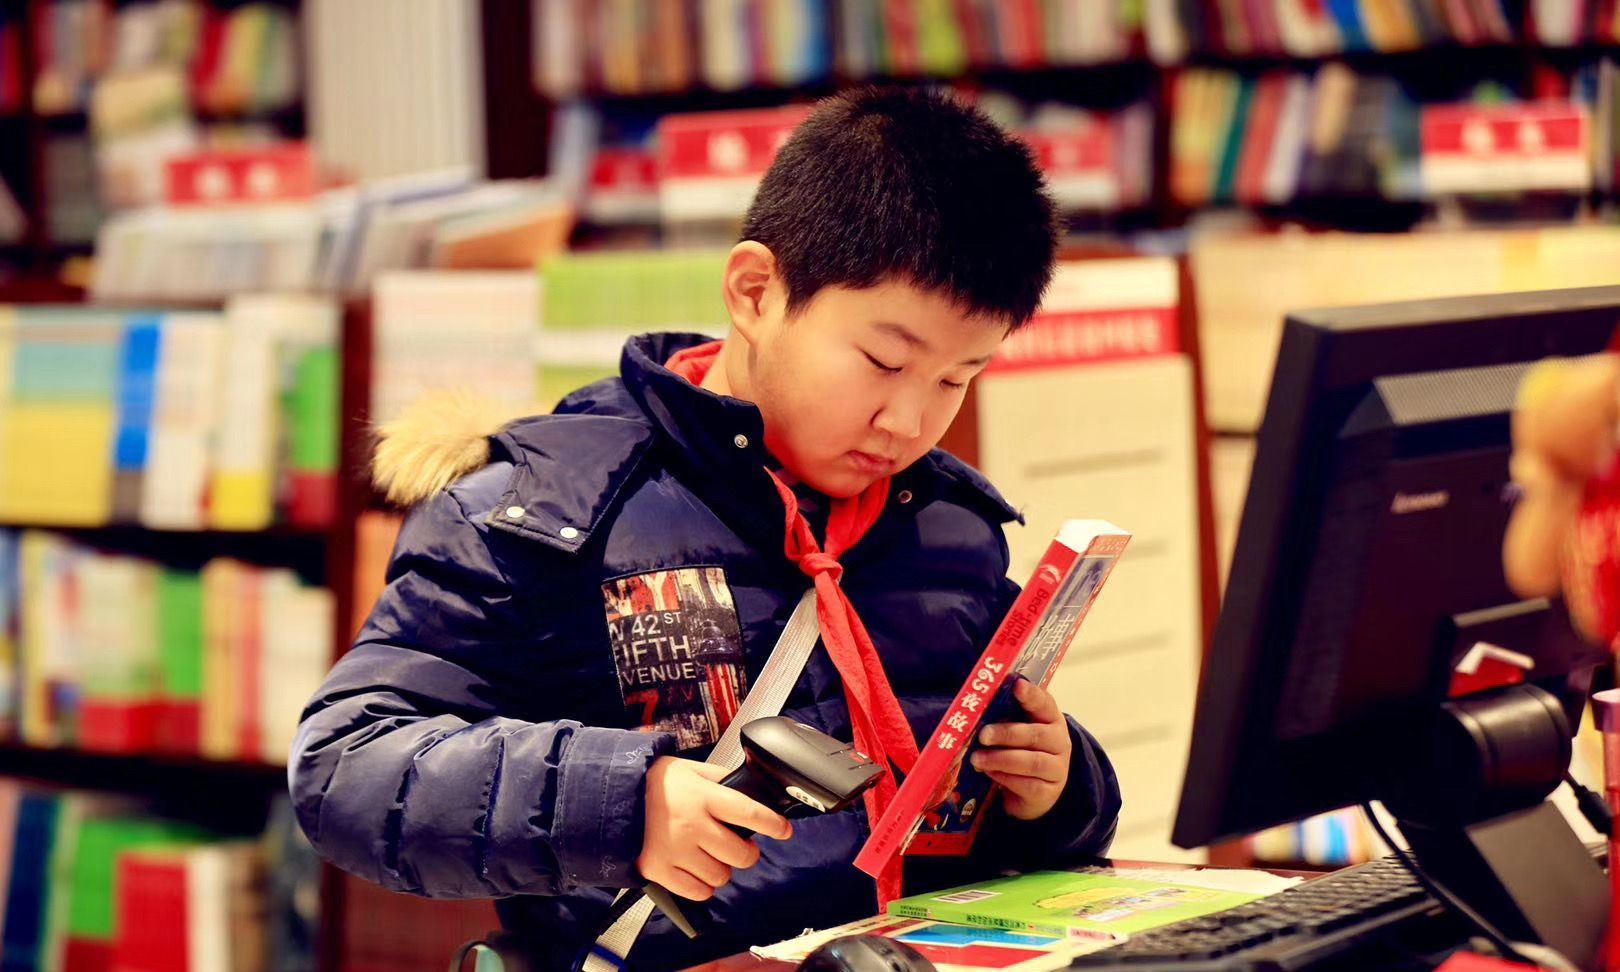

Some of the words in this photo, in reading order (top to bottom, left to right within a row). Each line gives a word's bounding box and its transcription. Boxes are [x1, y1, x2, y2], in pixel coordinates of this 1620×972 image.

[631, 614, 661, 636] 42
[663, 611, 682, 624] ST
[620, 662, 697, 686] VENUE
[937, 655, 1004, 750] 365夜故事
